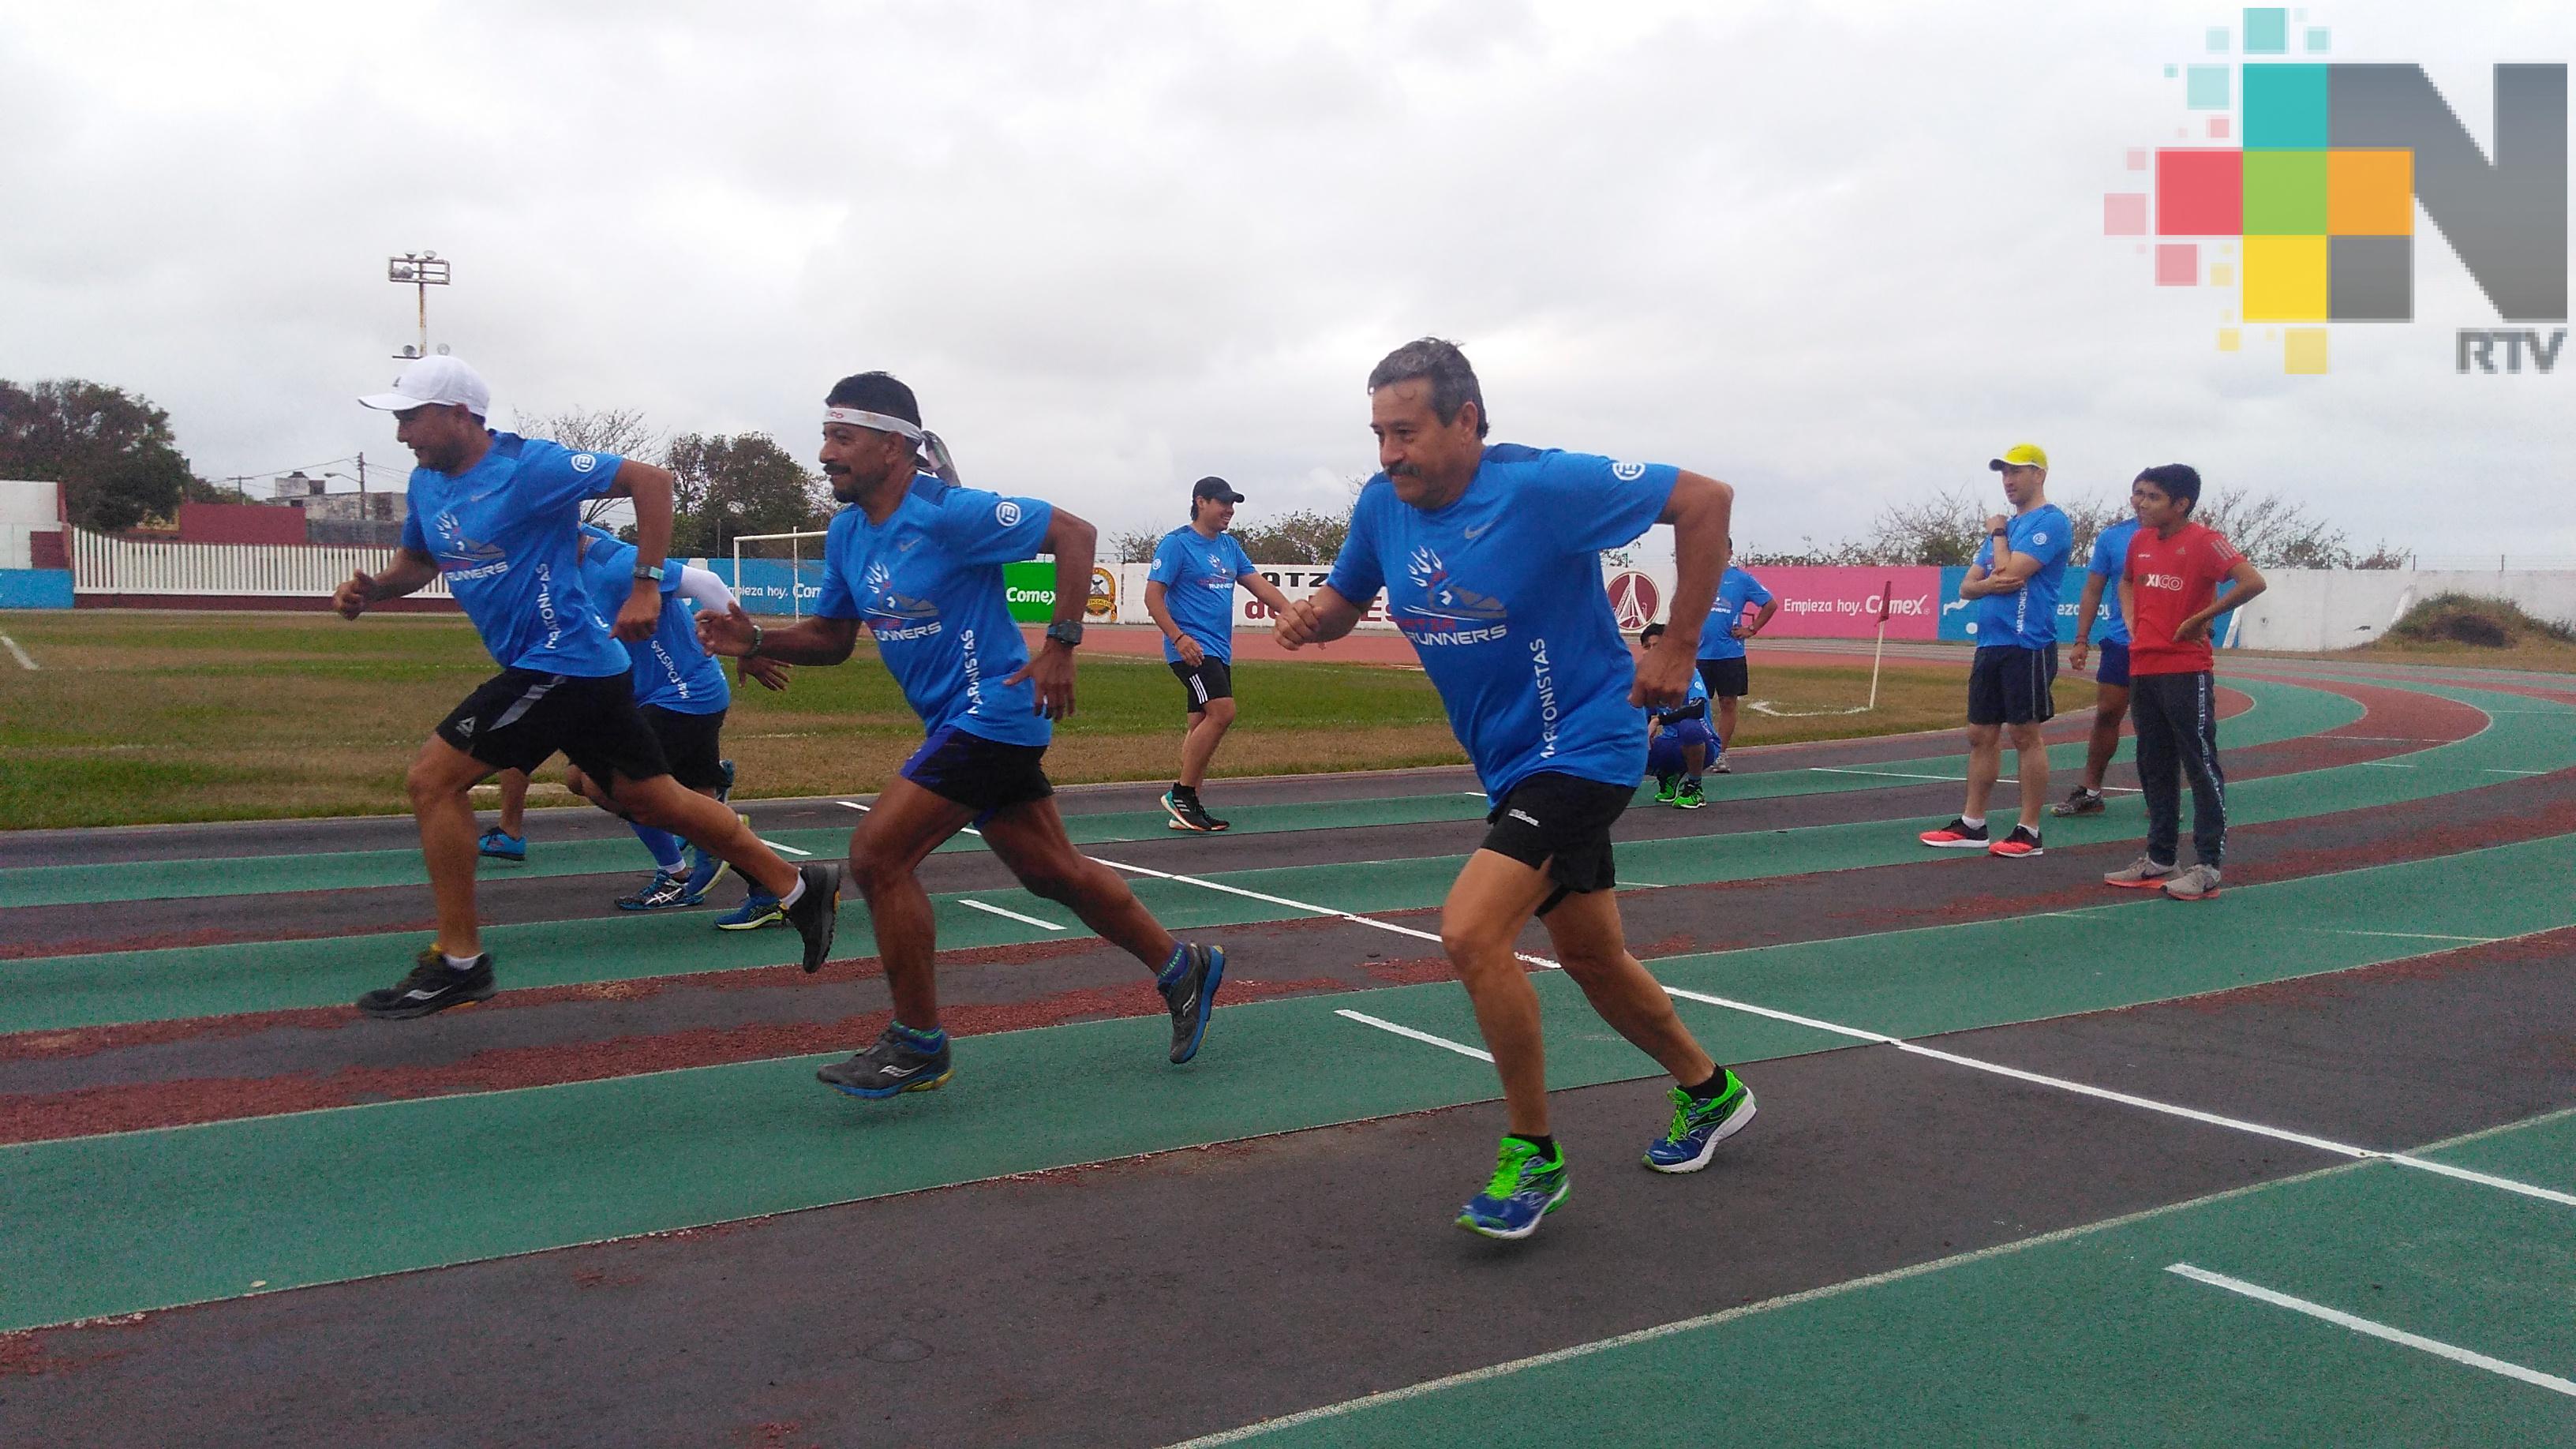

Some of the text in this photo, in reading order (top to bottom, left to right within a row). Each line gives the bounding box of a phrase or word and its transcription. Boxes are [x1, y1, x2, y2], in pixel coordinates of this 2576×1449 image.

[1784, 594, 1928, 616] Empieza hoy. Cmex
